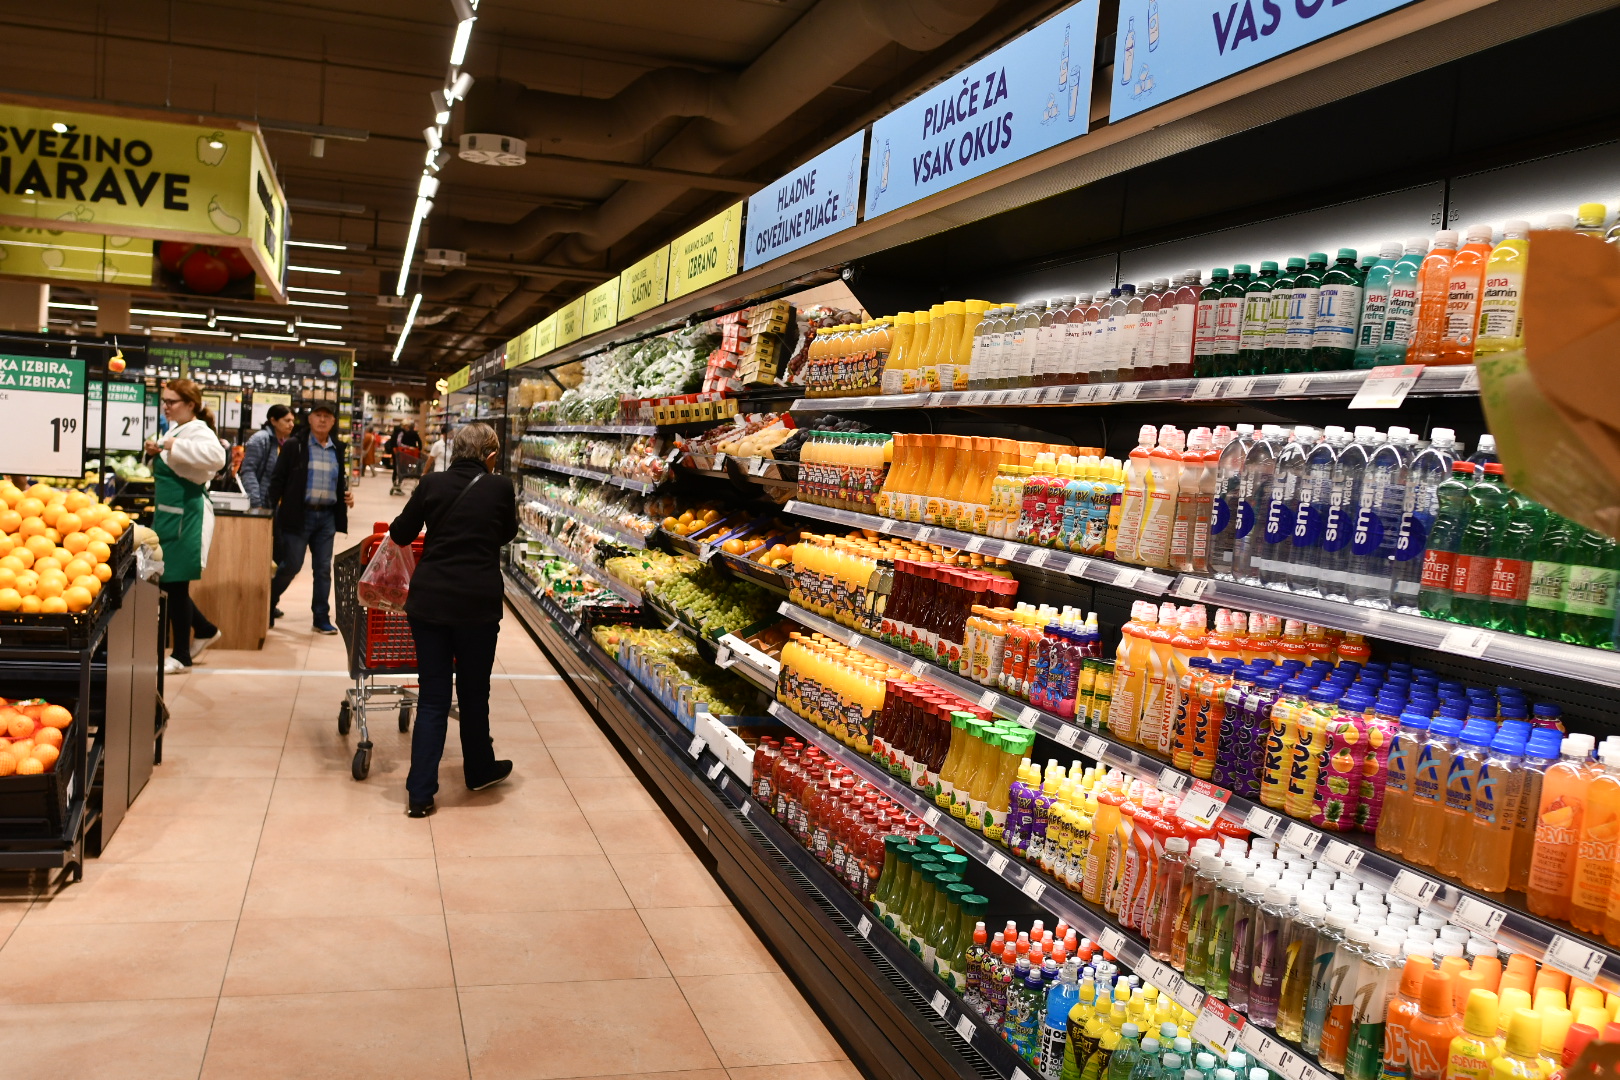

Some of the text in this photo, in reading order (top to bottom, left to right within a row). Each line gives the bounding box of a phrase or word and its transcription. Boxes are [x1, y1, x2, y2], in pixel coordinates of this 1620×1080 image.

[923, 66, 1008, 140] PIJAČE ZA
[912, 111, 1014, 187] VSAK OKUS
[756, 189, 840, 255] OSVEŽILNE PIJAČE
[777, 169, 817, 213] HLADNE
[20, 375, 71, 390] IZBIRA!
[22, 360, 74, 377] IZBIRA,
[107, 392, 137, 402] IZBIRA!
[108, 384, 138, 394] IZBIRA,
[1160, 682, 1174, 748] CARNITINE
[1215, 706, 1237, 767] FRUC
[1234, 712, 1256, 776] FRUC
[1264, 722, 1287, 786] FRUC
[1288, 729, 1313, 796] FRUC
[1121, 856, 1134, 919] CARNITINE
[1041, 1026, 1052, 1073] OSHEE
